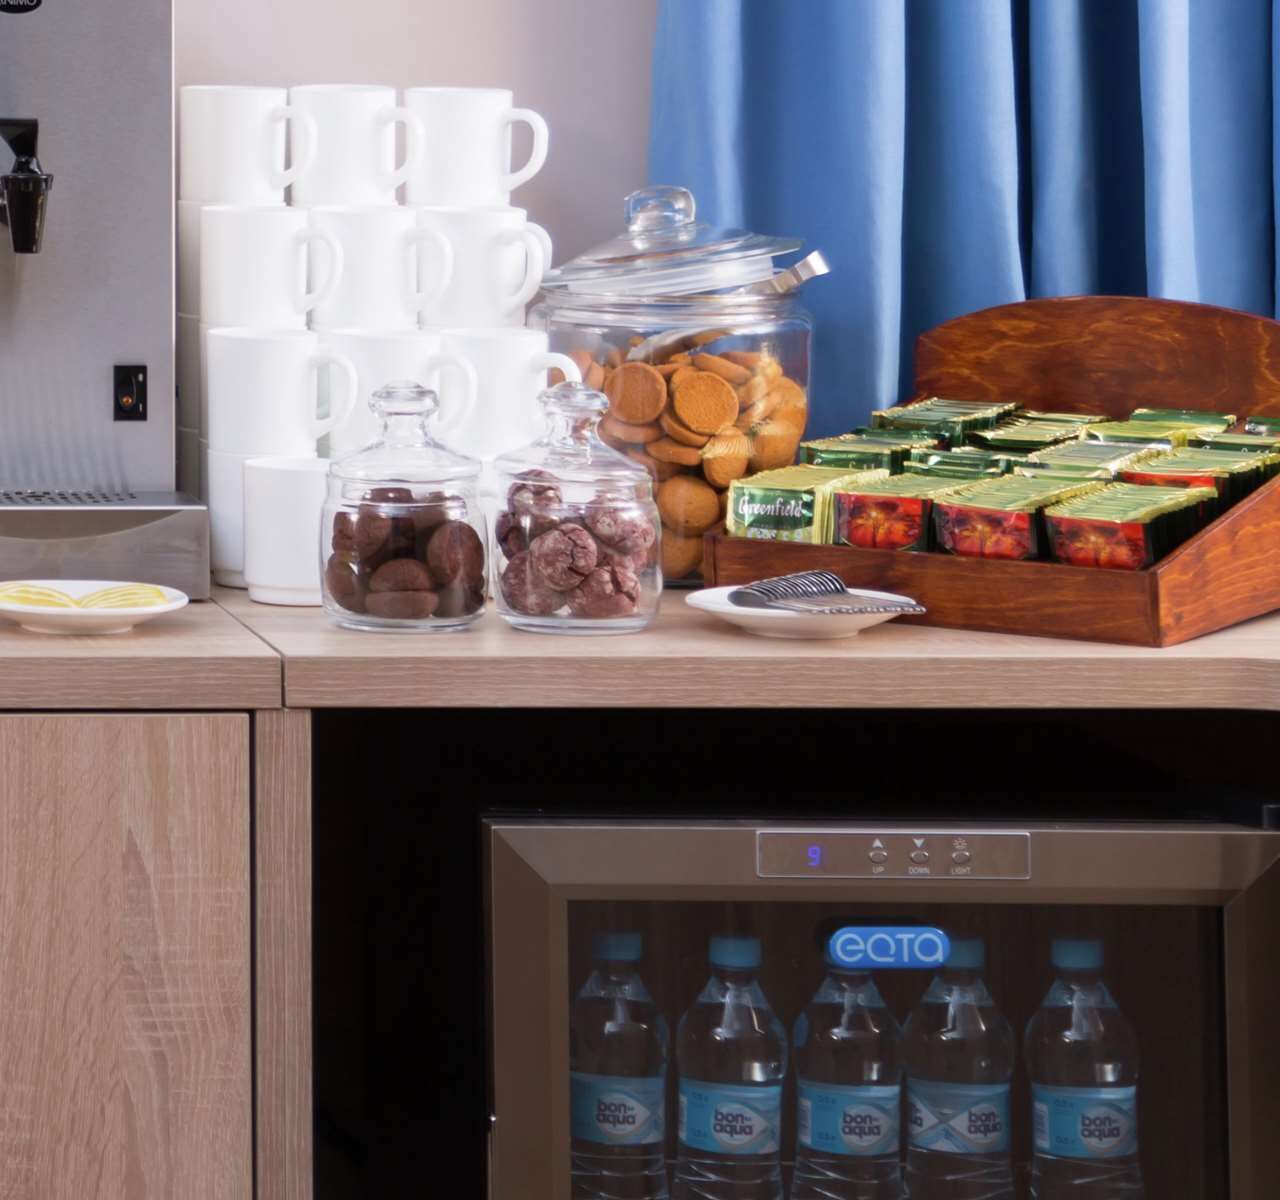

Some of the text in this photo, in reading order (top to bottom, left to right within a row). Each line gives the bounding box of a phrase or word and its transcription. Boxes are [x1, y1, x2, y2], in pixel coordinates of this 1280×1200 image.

[738, 495, 803, 517] Greenfield
[808, 846, 821, 866] 9
[596, 1112, 635, 1127] aqua
[713, 1122, 752, 1136] aqua
[841, 1124, 880, 1138] aqua
[967, 1123, 1000, 1136] aqua
[1081, 1127, 1120, 1141] aqua
